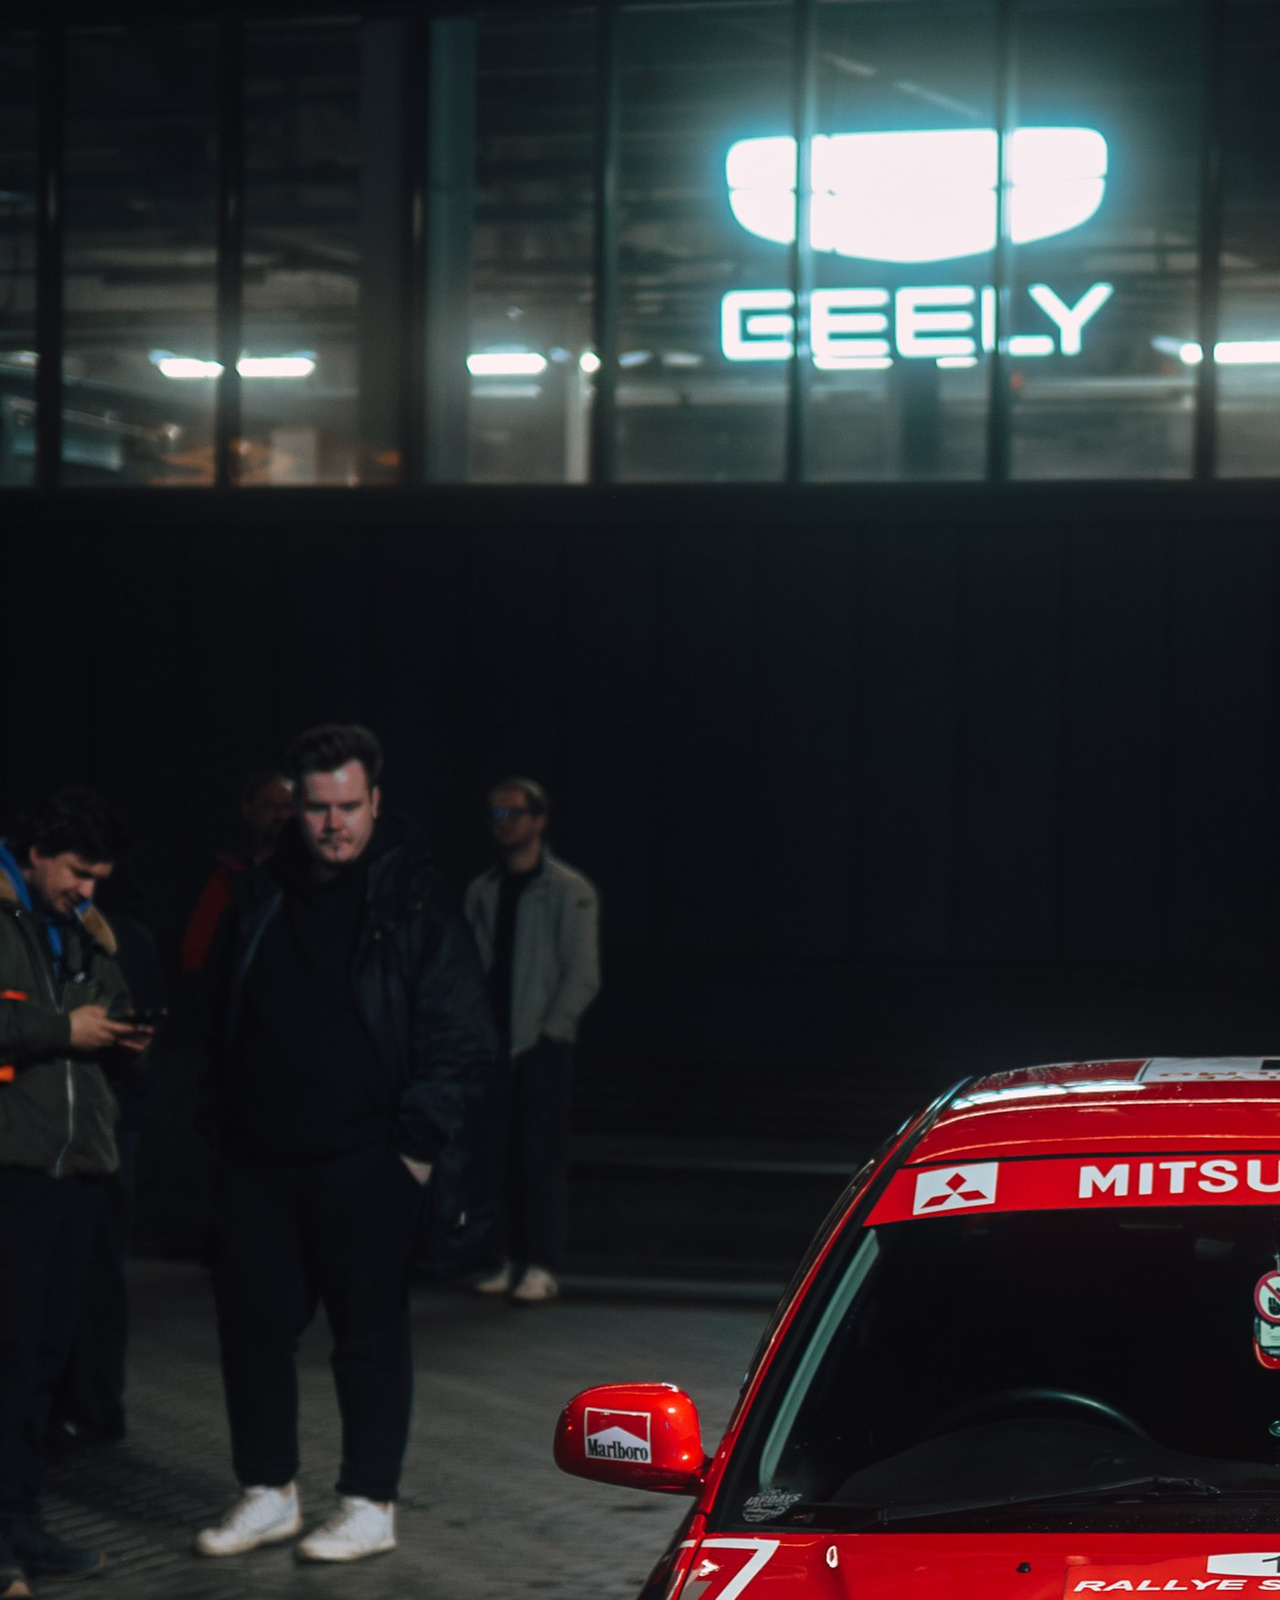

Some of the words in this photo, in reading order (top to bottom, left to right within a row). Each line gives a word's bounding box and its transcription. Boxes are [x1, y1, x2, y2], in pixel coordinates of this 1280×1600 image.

[721, 282, 1113, 361] GEELY
[587, 1438, 649, 1461] Marlboro
[1074, 1579, 1247, 1592] RALLYE
